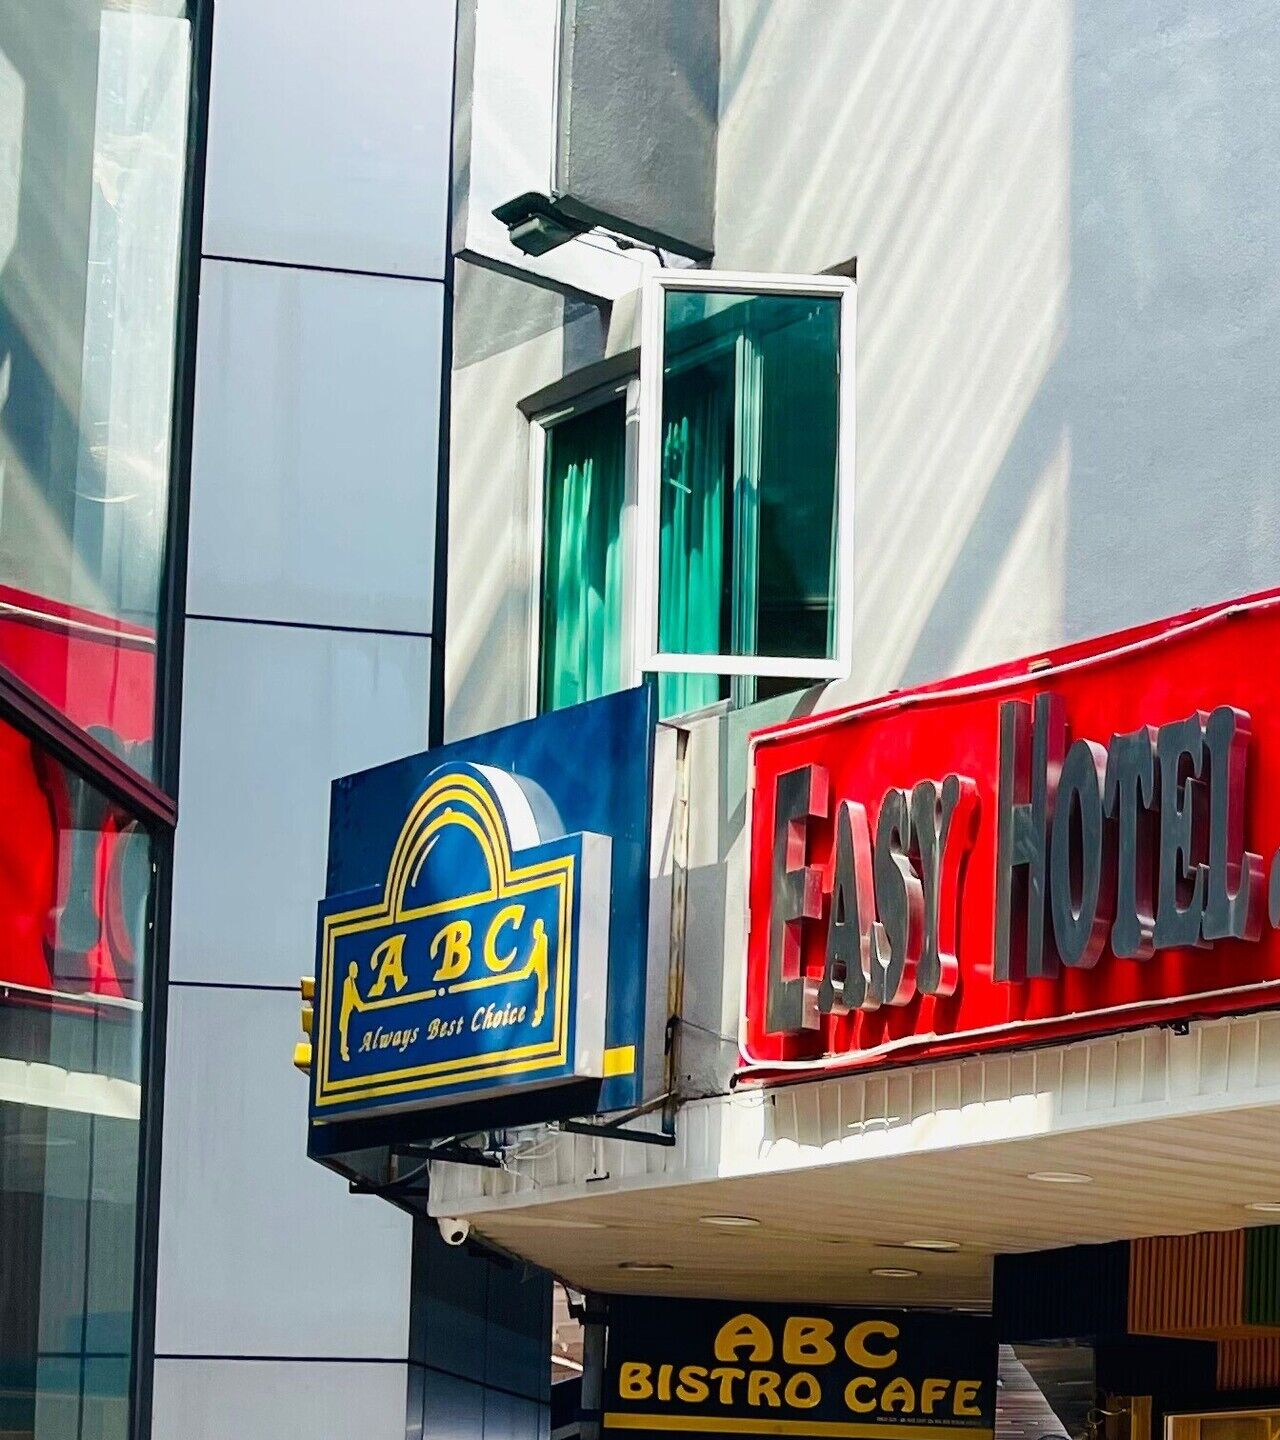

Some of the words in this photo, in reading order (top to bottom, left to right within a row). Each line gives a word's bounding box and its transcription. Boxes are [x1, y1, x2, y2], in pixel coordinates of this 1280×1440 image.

[767, 763, 980, 1036] EASY
[357, 1023, 421, 1053] Always
[426, 1017, 464, 1041] Best
[469, 1002, 527, 1032] Choice
[713, 1313, 900, 1369] ABC
[618, 1361, 823, 1409] BISTRO
[844, 1376, 984, 1417] CAFE
